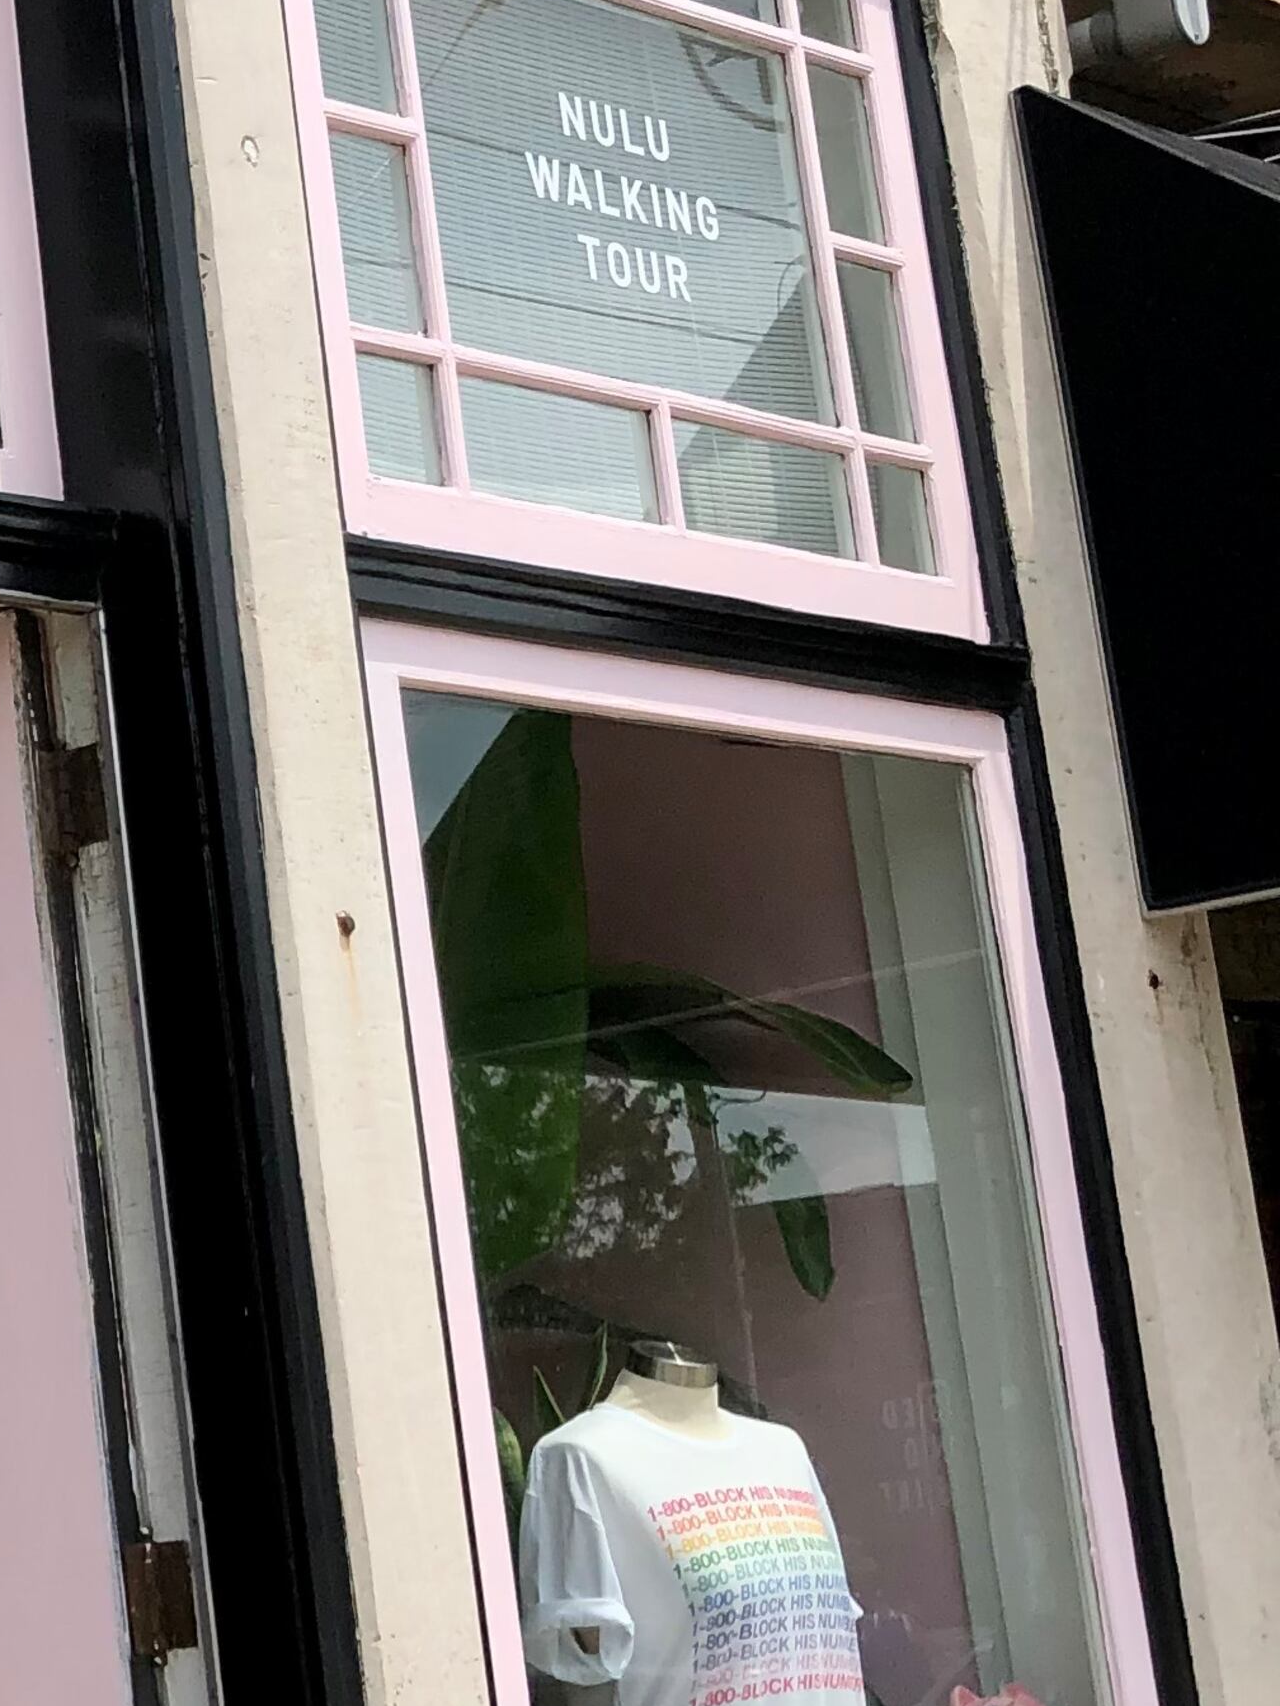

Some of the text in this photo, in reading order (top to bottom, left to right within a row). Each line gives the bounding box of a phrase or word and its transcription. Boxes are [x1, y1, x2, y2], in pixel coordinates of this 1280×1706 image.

[558, 91, 671, 162] NULU
[524, 150, 720, 241] WALKING
[576, 233, 693, 303] TOUR
[789, 1574, 811, 1591] HIS
[791, 1593, 813, 1610] HIS
[792, 1614, 815, 1631] HIS
